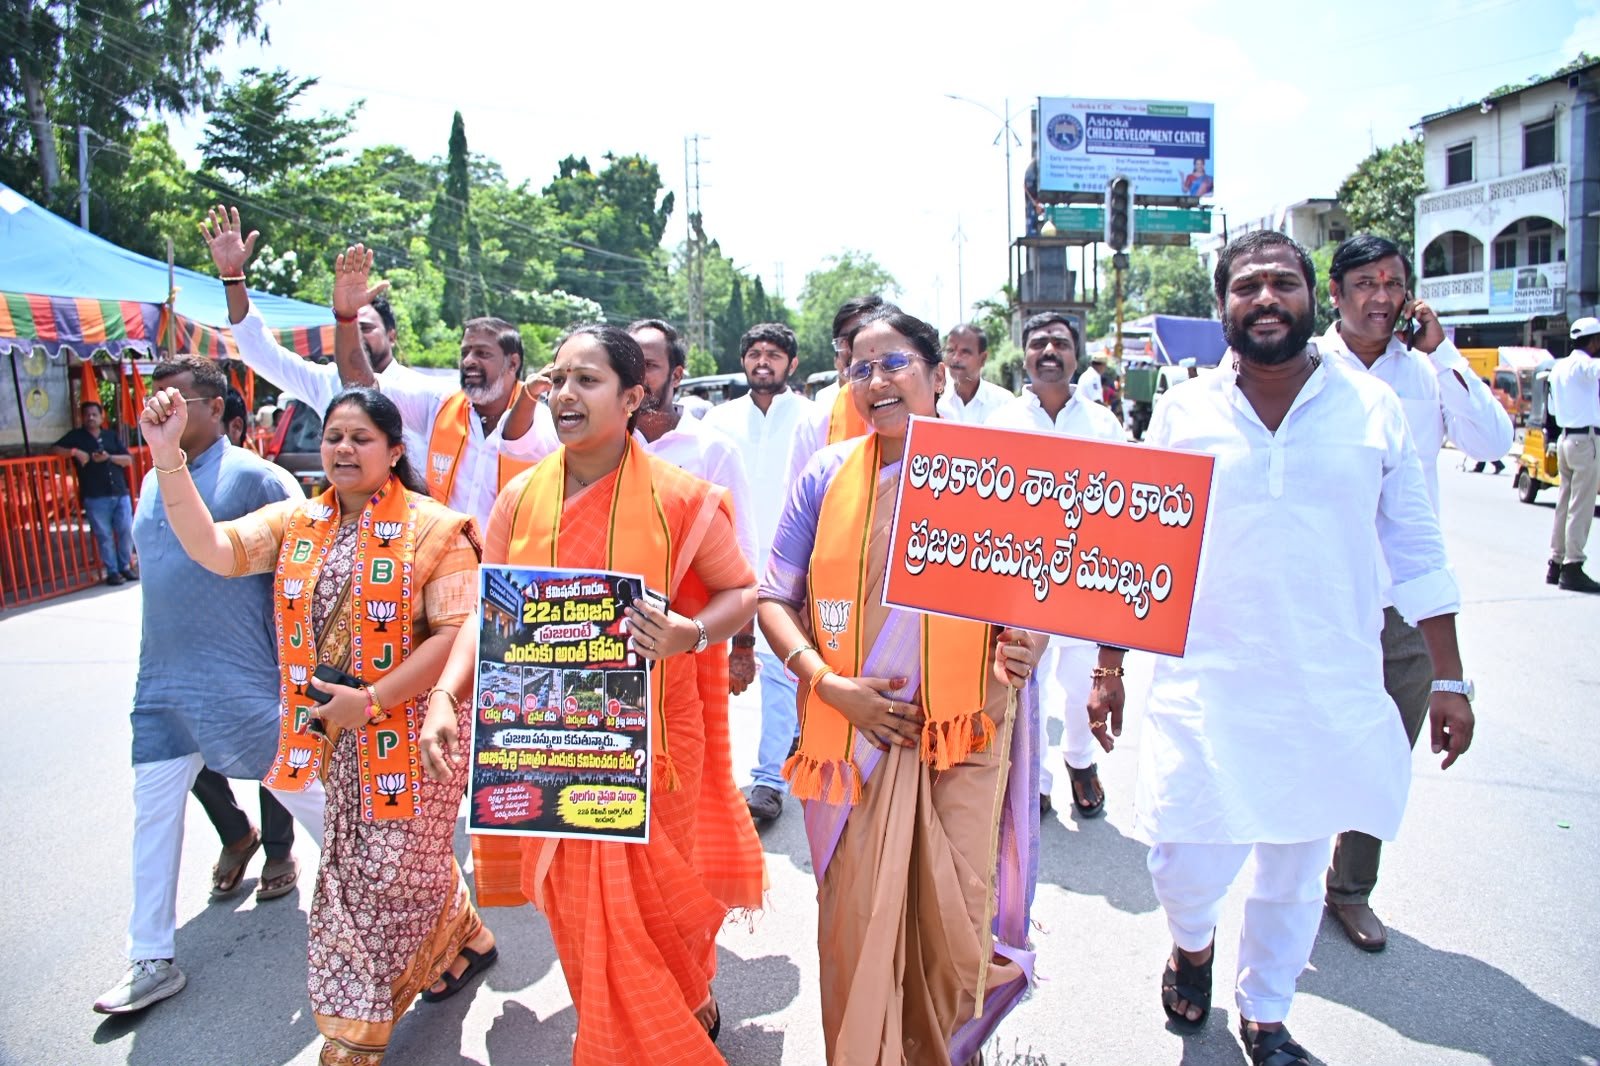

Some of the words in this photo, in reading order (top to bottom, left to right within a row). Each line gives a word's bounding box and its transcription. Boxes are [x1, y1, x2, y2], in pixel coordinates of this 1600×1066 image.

[1088, 116, 1129, 128] Ashoka
[1086, 127, 1113, 140] CHILD
[1114, 128, 1173, 143] DEVELOPMENT
[1174, 131, 1206, 144] CENTRE
[1514, 288, 1552, 297] DIAMOND
[909, 453, 1015, 501] అధికారం
[1020, 467, 1125, 530] శాశ్వతం
[1128, 482, 1194, 528] కాదు
[292, 539, 313, 564] B
[370, 558, 394, 584] B
[905, 518, 967, 576] ప్రజల
[970, 529, 1077, 602] సమస్యలే
[1076, 546, 1172, 619] ముఖ్యం
[545, 583, 581, 599] కమిషనర్
[523, 602, 561, 624] 22వ
[563, 597, 614, 622] డివిజన్
[289, 621, 302, 649] J
[539, 622, 592, 642] ప్రజలంటే
[373, 644, 392, 671] J
[504, 643, 553, 663] ఎందుకు
[555, 645, 587, 662] అంత
[588, 636, 624, 662] కోపం
[377, 730, 399, 759] P
[503, 731, 531, 746] ప్రజలు
[532, 732, 562, 749] పన్నులు
[564, 733, 619, 750] కడుతున్నారు..
[478, 749, 518, 772] అభివృద్ధి
[519, 750, 546, 768] మాత్రం
[548, 752, 576, 768] ఎందుకు
[577, 753, 618, 769] కనిపించడం
